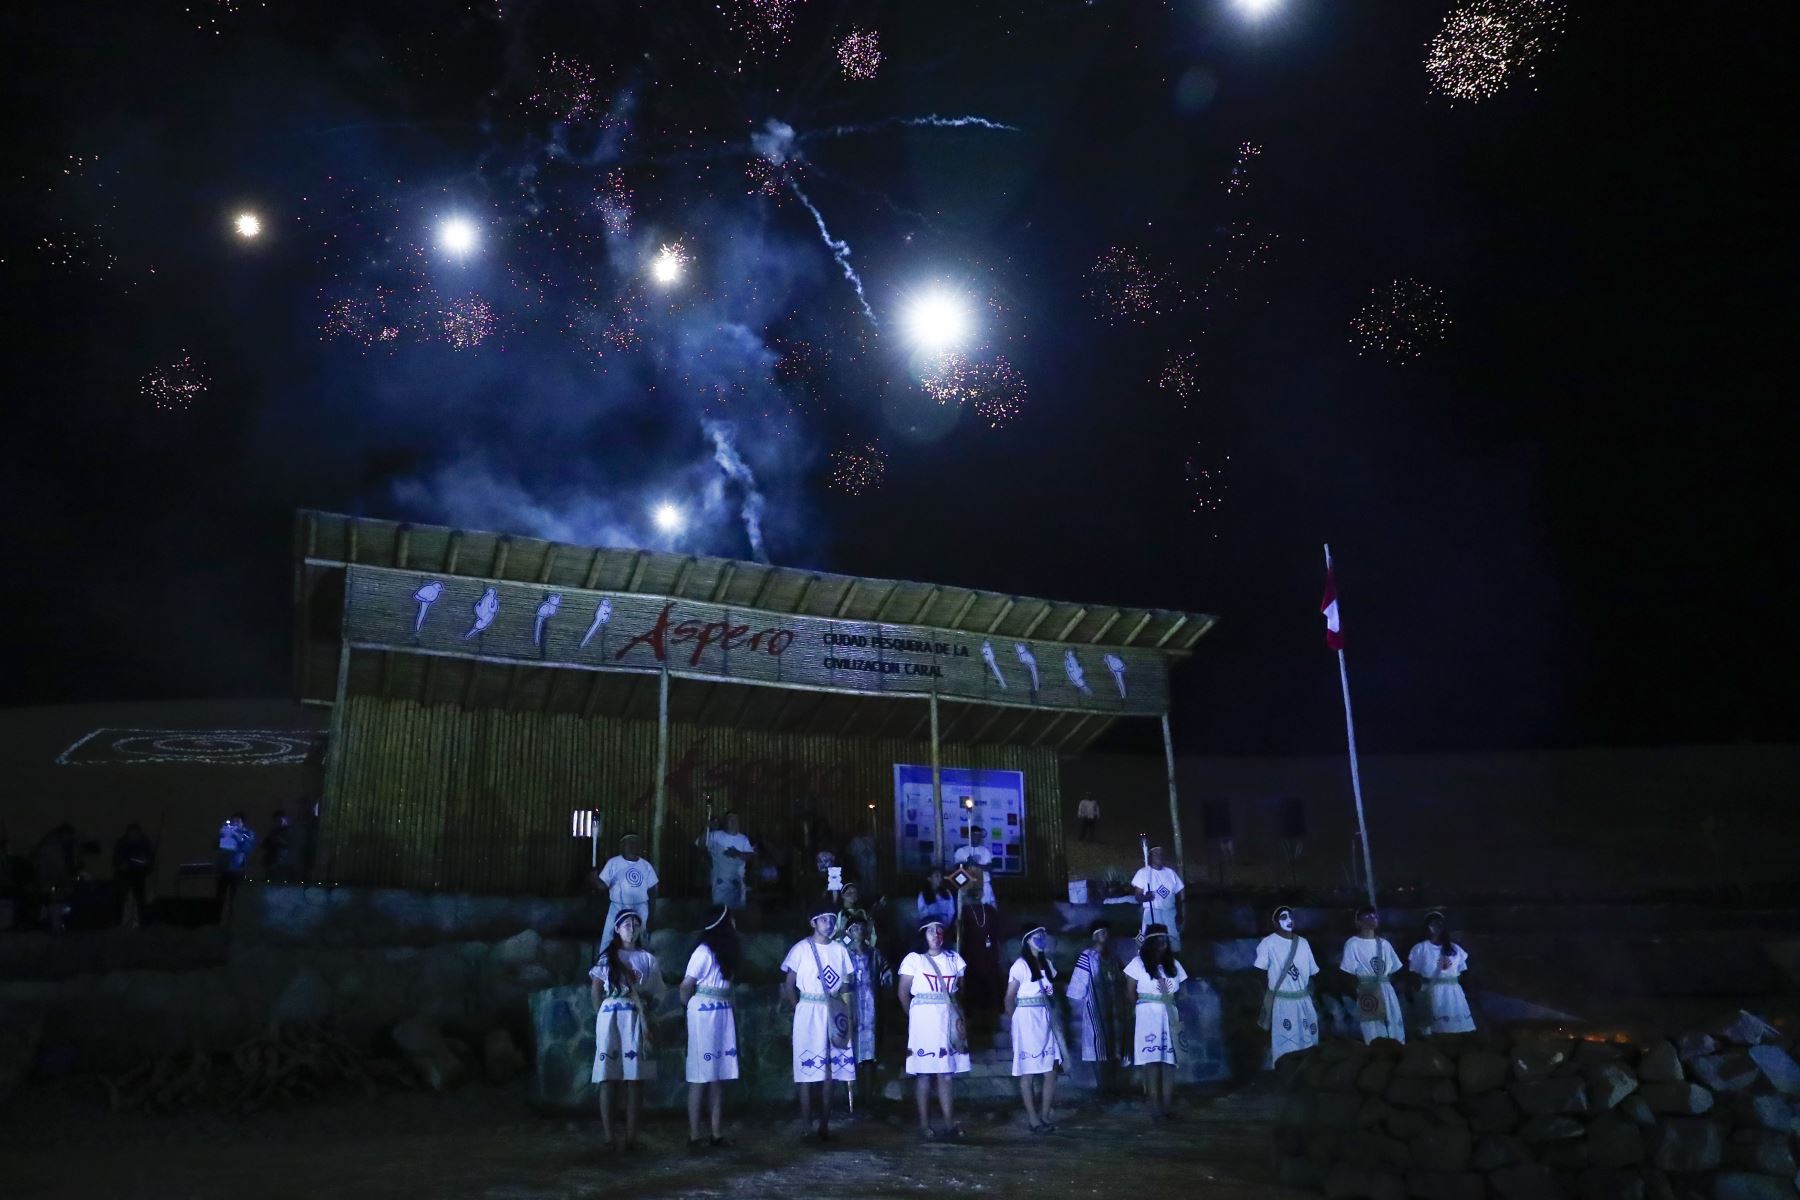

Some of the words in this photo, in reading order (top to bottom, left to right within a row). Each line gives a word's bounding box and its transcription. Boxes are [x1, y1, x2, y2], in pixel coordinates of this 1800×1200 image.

[615, 602, 794, 666] Aspero
[823, 633, 867, 648] CIUDAD
[872, 637, 933, 653] PESQUERA
[935, 643, 950, 654] DE
[954, 645, 969, 658] LA
[905, 663, 944, 678] CARAL
